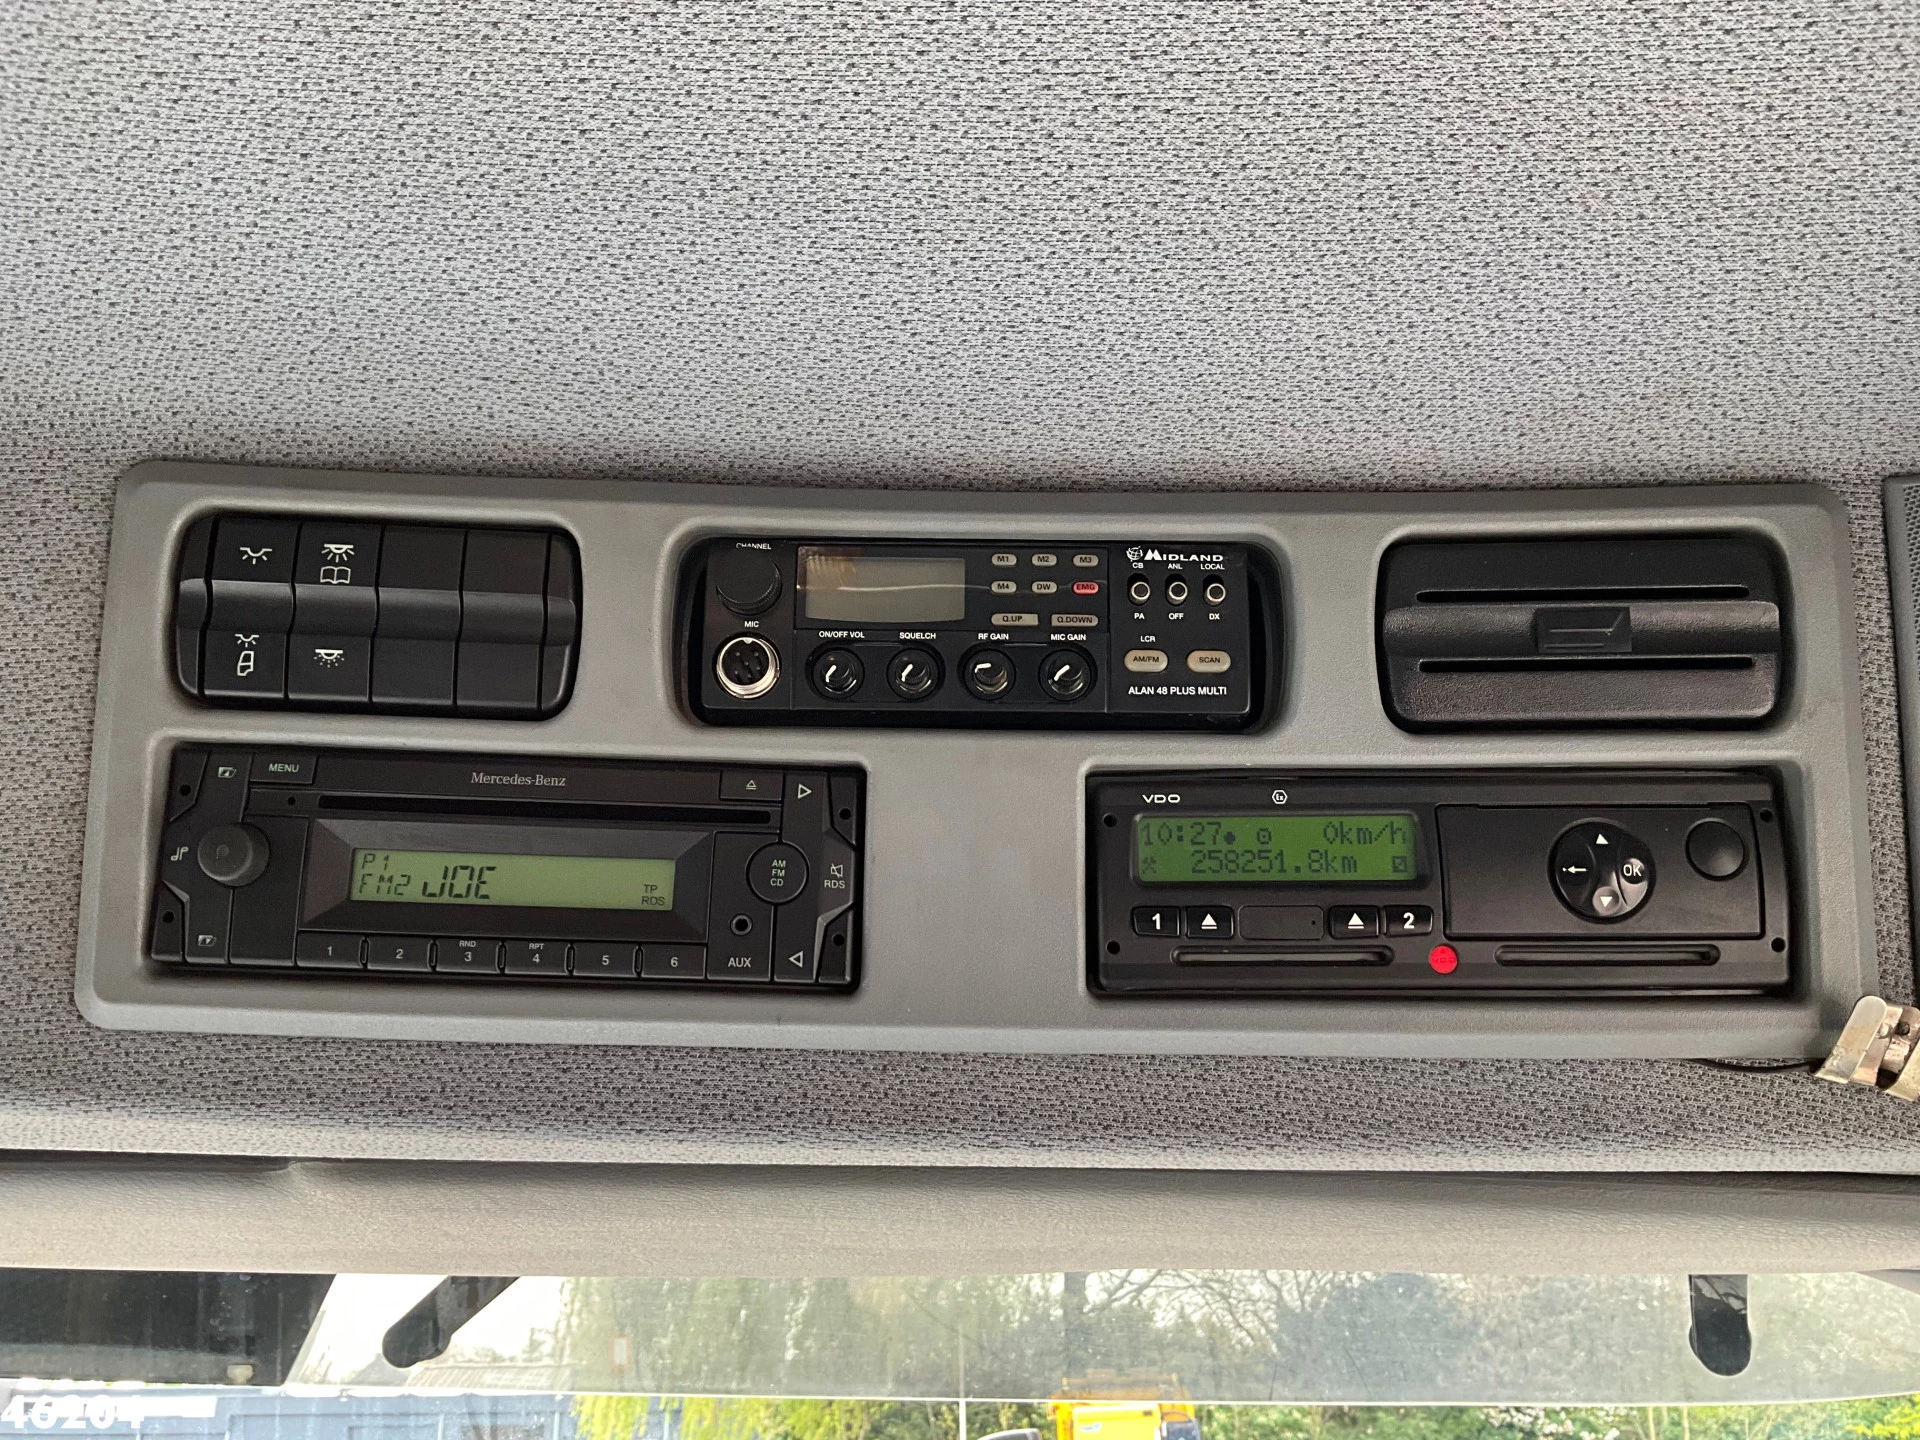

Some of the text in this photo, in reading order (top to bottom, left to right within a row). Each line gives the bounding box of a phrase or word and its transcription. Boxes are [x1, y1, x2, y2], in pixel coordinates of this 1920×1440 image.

[997, 555, 1010, 563] M1
[1037, 555, 1050, 563] M2
[1144, 549, 1223, 561] MIDLAND
[1079, 556, 1092, 564] M3
[1076, 583, 1096, 591] EMG
[1002, 615, 1023, 623] Q.UP
[1057, 616, 1093, 624] Q.DOWN
[744, 620, 759, 628] MIC
[819, 630, 865, 639] ON/OFF VOL
[899, 632, 936, 640] SQUELCH
[1051, 633, 1066, 641] MIC
[1140, 635, 1155, 643] LCR
[1133, 655, 1160, 664] AM/FM
[1198, 656, 1221, 664] SCAN
[1128, 686, 1227, 695] ALAN 48 PLUS MULTI
[268, 764, 299, 773] MENU
[471, 772, 567, 787] Mercedes-Benz
[1142, 794, 1181, 803] VDO
[1142, 821, 1222, 846] 10:27
[771, 859, 786, 868] AM
[1191, 849, 1358, 874] 258251.8km
[771, 868, 785, 877] FM
[1623, 864, 1643, 877] OK
[359, 865, 497, 899] FM2 JOE
[770, 877, 784, 887] CD
[824, 879, 846, 889] RDS
[643, 884, 658, 893] TP
[641, 895, 665, 906] RDS
[1151, 913, 1161, 929] 1
[1403, 912, 1415, 929] 2
[459, 940, 476, 948] RND
[327, 946, 333, 956] 1
[395, 949, 404, 959] 2
[464, 952, 472, 962] 3
[532, 953, 540, 963] 4
[602, 955, 610, 965] 5
[670, 957, 678, 967] 6
[728, 957, 752, 968] AUX
